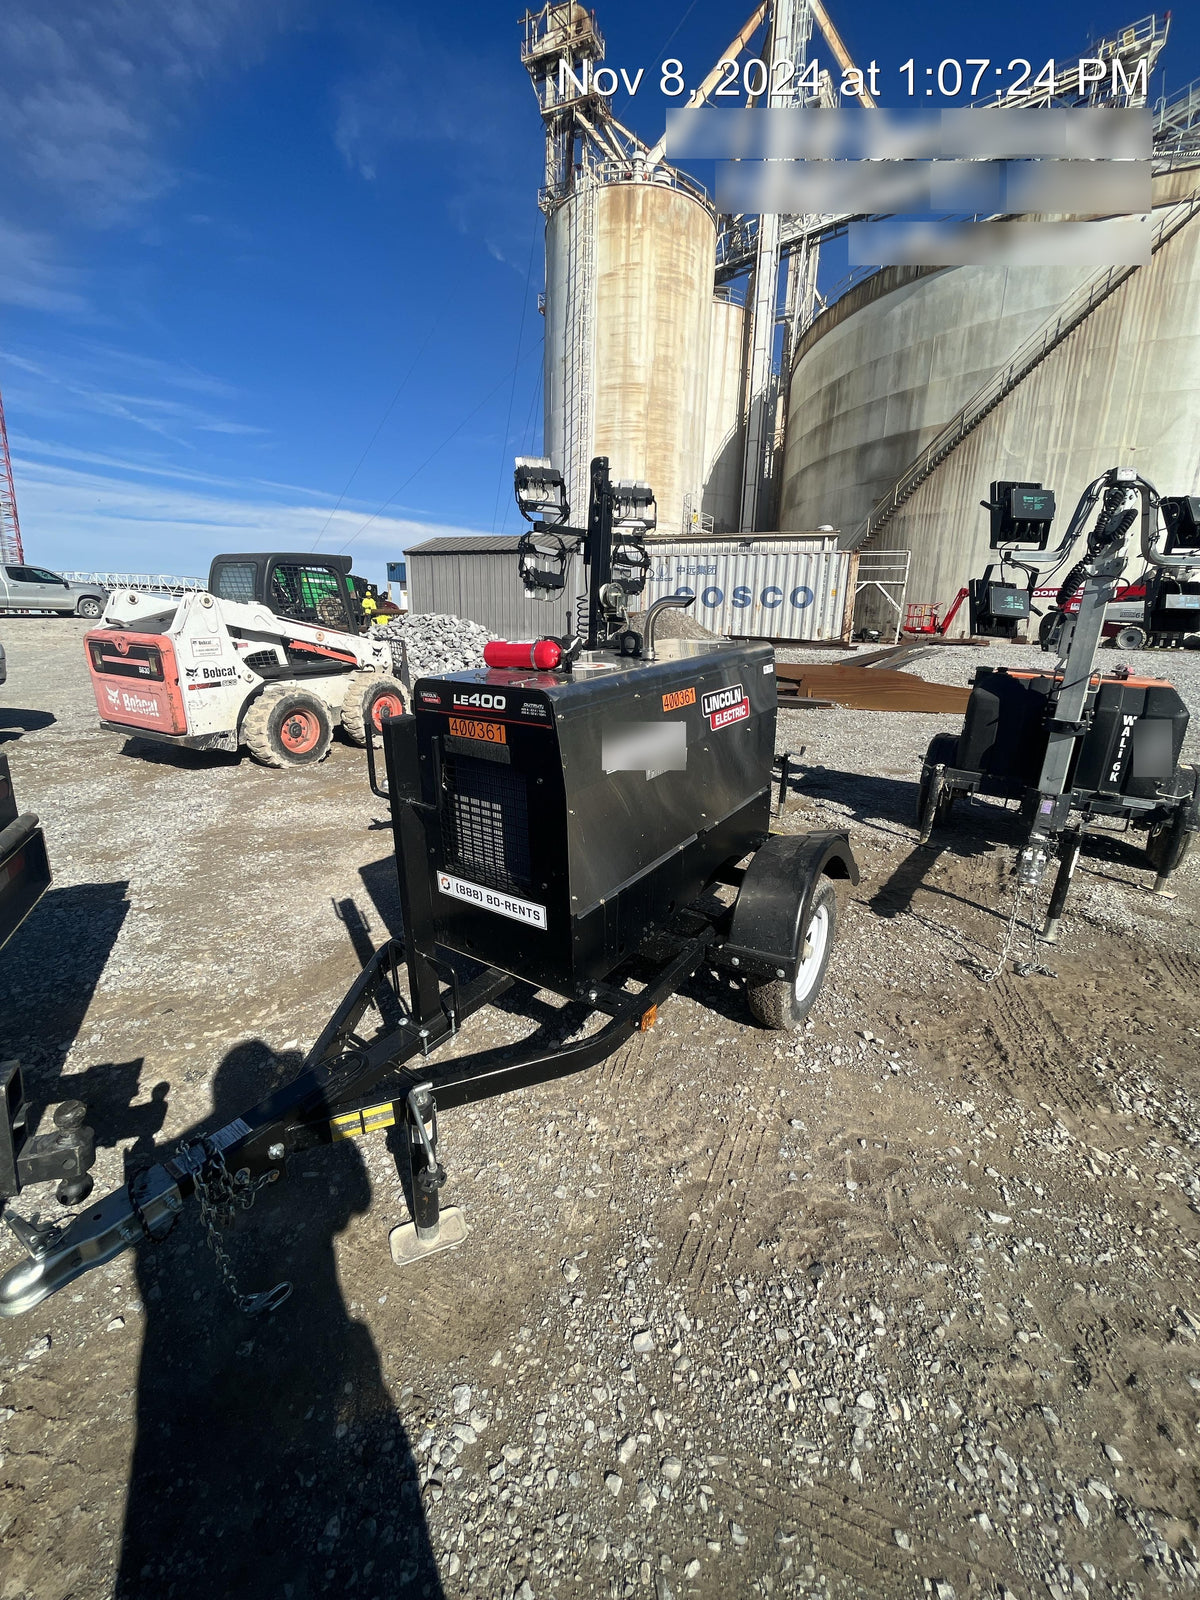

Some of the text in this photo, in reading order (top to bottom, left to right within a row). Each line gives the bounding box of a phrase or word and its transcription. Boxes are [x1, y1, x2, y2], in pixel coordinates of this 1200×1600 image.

[1032, 589, 1058, 597] OOM
[202, 665, 237, 679] Bobcat
[122, 692, 161, 718] Bobcat
[453, 693, 506, 710] LE400
[664, 688, 695, 709] 400361
[703, 687, 742, 714] LINCOLN
[715, 704, 747, 726] ELECTRIC
[450, 718, 504, 742] 400361
[455, 882, 541, 921] (888) 80-RENTS
